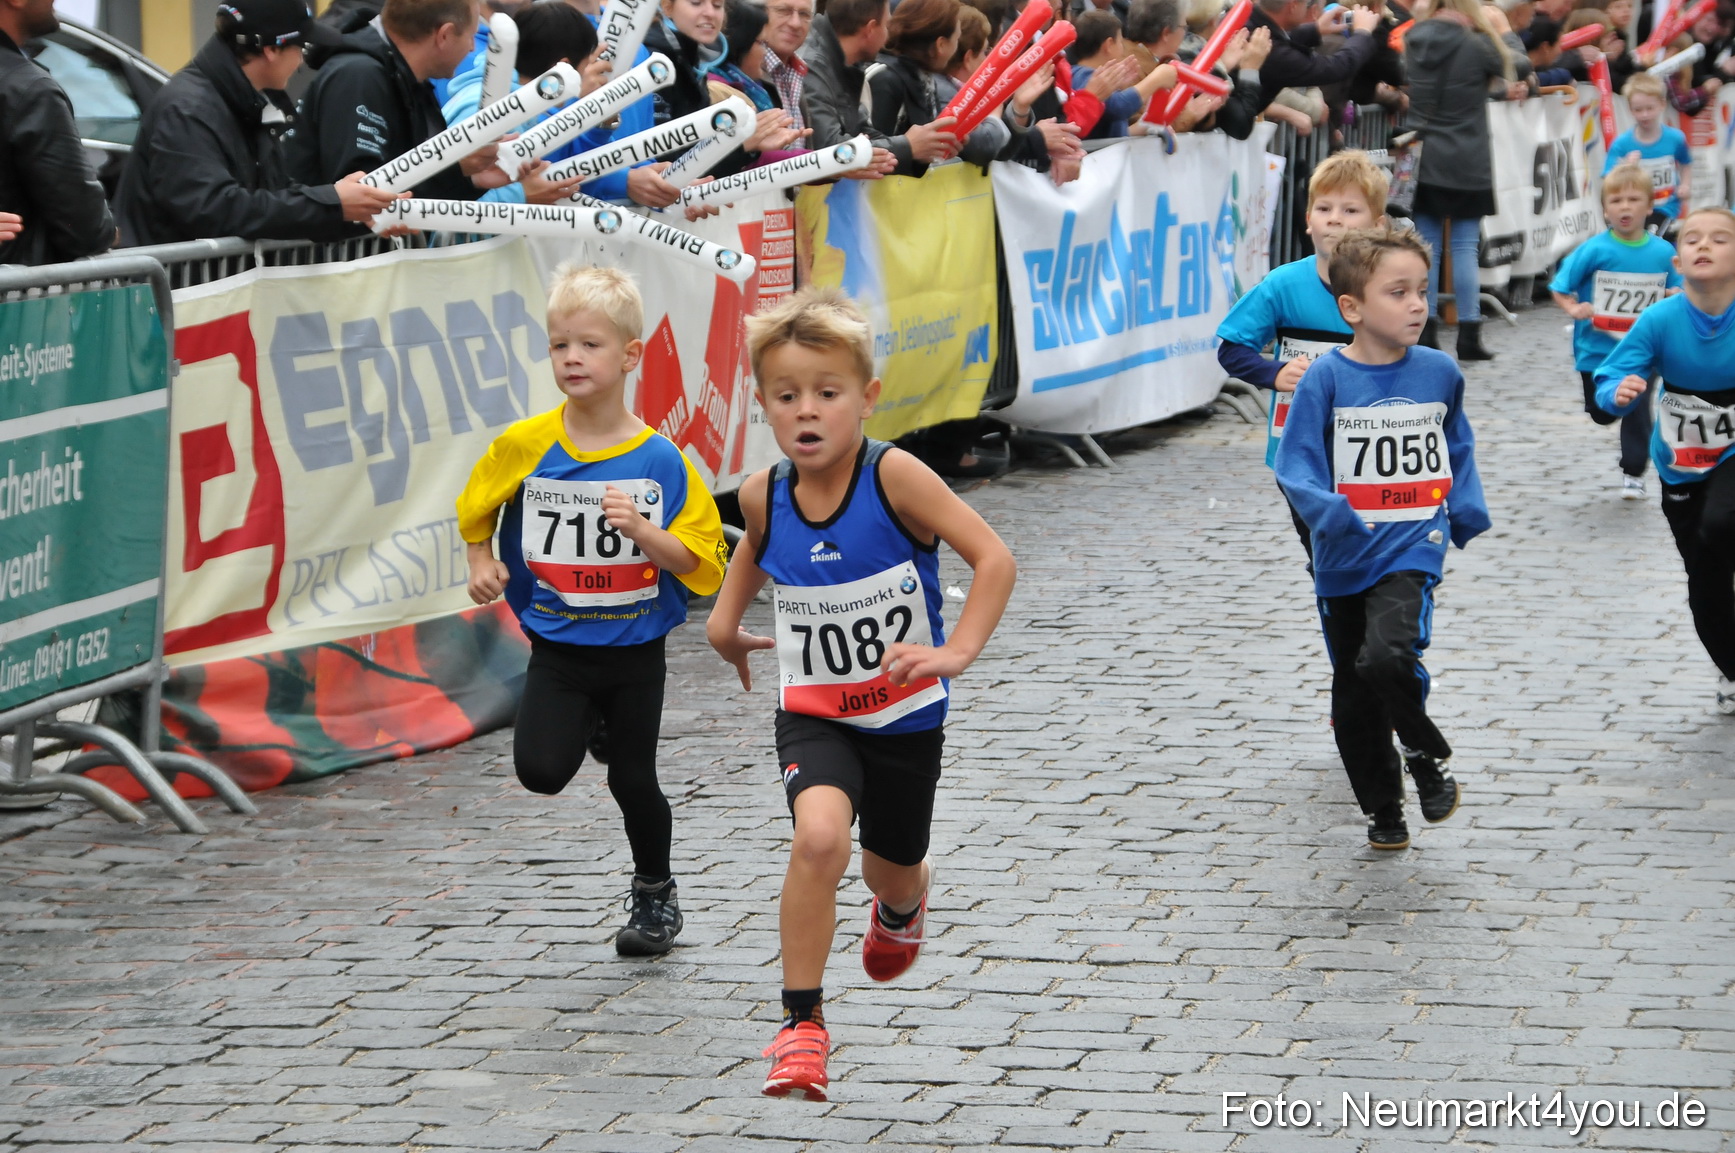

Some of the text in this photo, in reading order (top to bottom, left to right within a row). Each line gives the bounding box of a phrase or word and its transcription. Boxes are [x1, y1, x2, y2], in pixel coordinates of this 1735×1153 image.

[952, 63, 996, 116] Audi BKK
[988, 73, 1012, 97] BKK
[364, 93, 525, 188] bmw-laufsport.d
[547, 123, 700, 182] BMW Laufspo
[649, 223, 706, 256] BMW
[0, 342, 74, 386] eit-Systeme
[657, 395, 689, 443] aun
[1337, 415, 1432, 429] PARTL Neumarkt
[1347, 431, 1441, 478] 7058
[526, 489, 570, 504] PARTL
[1382, 488, 1417, 505] Paul
[283, 517, 468, 627] PFLASTE
[810, 551, 842, 563] skinfit
[572, 570, 612, 589] Tobi
[778, 587, 895, 616] PARTL Neumarkt
[33, 638, 72, 680] 09181
[76, 627, 109, 667] 6352
[790, 605, 913, 676] 7082
[838, 686, 889, 713] Joris
